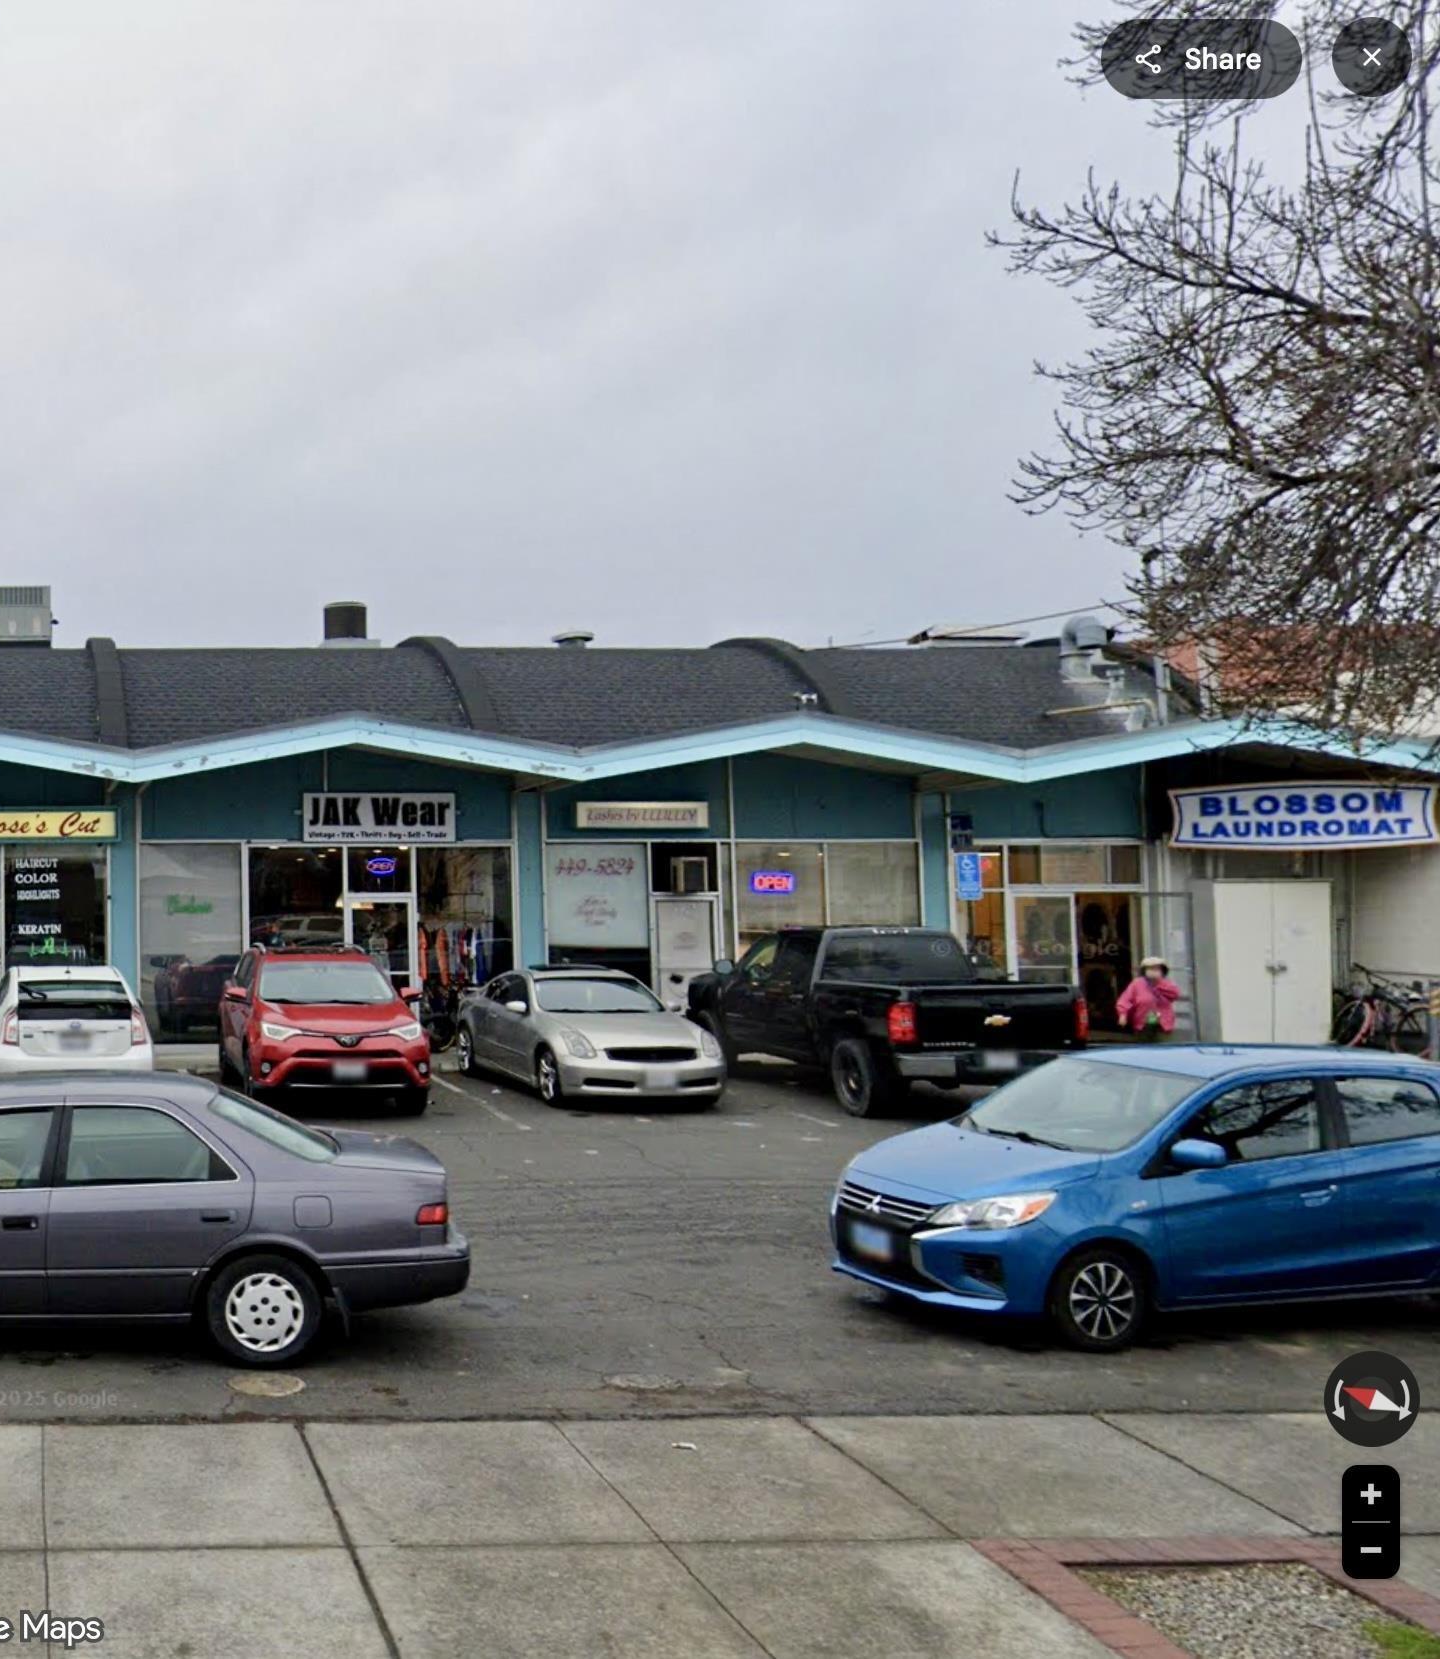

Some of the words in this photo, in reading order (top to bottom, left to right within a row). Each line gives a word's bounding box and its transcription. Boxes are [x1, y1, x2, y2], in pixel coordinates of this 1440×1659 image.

[309, 796, 362, 827] JAK
[371, 796, 450, 827] Wear
[1199, 791, 1403, 817] BLOSSOM
[60, 811, 101, 837] Cut
[1191, 818, 1413, 838] LAUNDROMAT
[15, 858, 59, 869] HAIRCUT
[14, 872, 58, 884] COLOR
[754, 875, 792, 890] OPEN
[16, 888, 60, 900] HIGHLIGHTS
[18, 923, 62, 935] KERATIN
